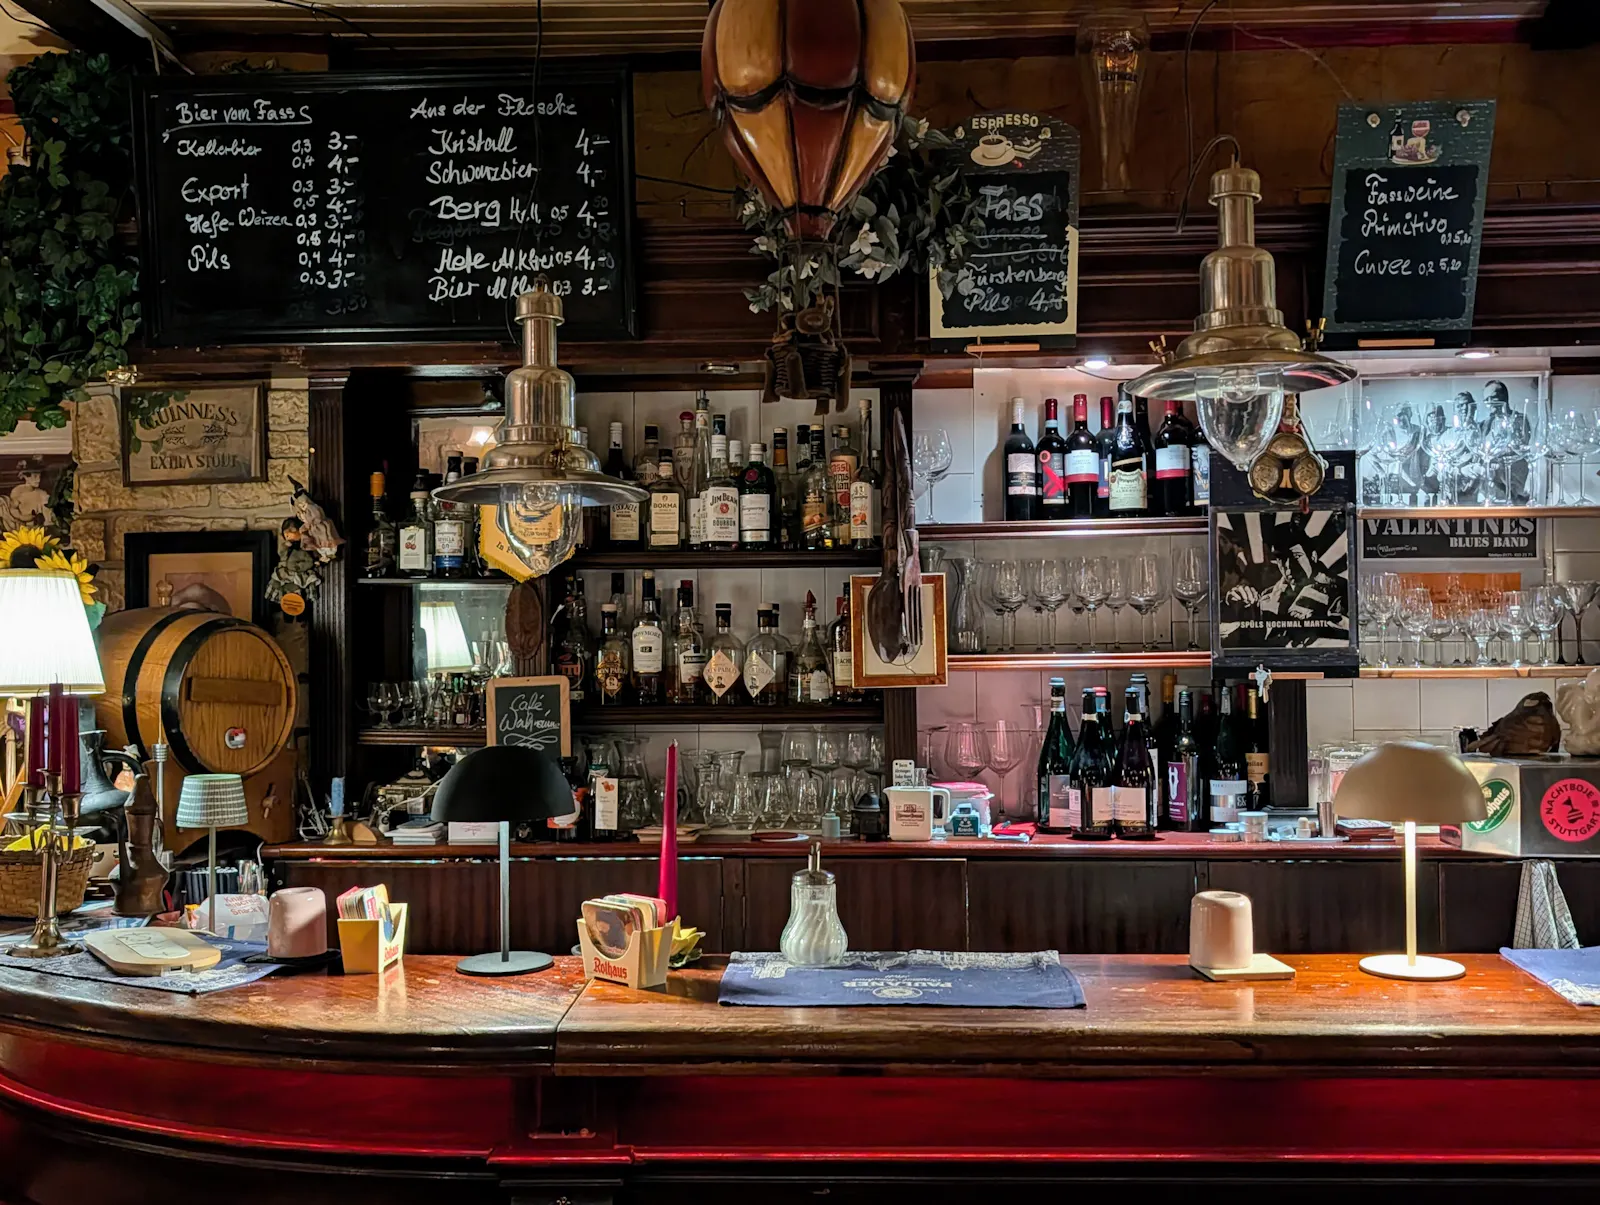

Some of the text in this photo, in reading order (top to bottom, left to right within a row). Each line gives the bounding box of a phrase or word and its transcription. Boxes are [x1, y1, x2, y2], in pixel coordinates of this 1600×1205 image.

[176, 102, 217, 124] Bier
[224, 107, 251, 123] vom
[410, 93, 578, 119] Aus der Flasche
[971, 113, 1039, 130] ESPRESSO
[177, 139, 262, 156] Kellerbier
[428, 126, 517, 155] Kristall
[426, 158, 540, 185] Schwarzbier
[181, 173, 250, 205] Export
[1365, 173, 1459, 206] Fassweine
[429, 195, 500, 227] Berg
[978, 184, 1044, 222] Fass
[1361, 208, 1448, 237] Primitivo
[188, 243, 231, 272] Pils
[1354, 249, 1413, 276] Cuvee
[427, 275, 480, 302] Bier
[964, 287, 1011, 313] Pils
[150, 452, 238, 470] EXTRA STOUT
[709, 493, 738, 507] JIM BEAM
[1366, 518, 1534, 536] VALENTINES
[1450, 536, 1529, 548] BLUES BAND
[633, 630, 661, 639] BOWMORE
[1240, 619, 1328, 629] SPÜLS NOCHMAL MARTL
[509, 692, 546, 711] Café
[1545, 783, 1595, 815] NACHTBOJE
[1548, 811, 1600, 837] STUTTGART
[842, 980, 953, 988] PAULANER
